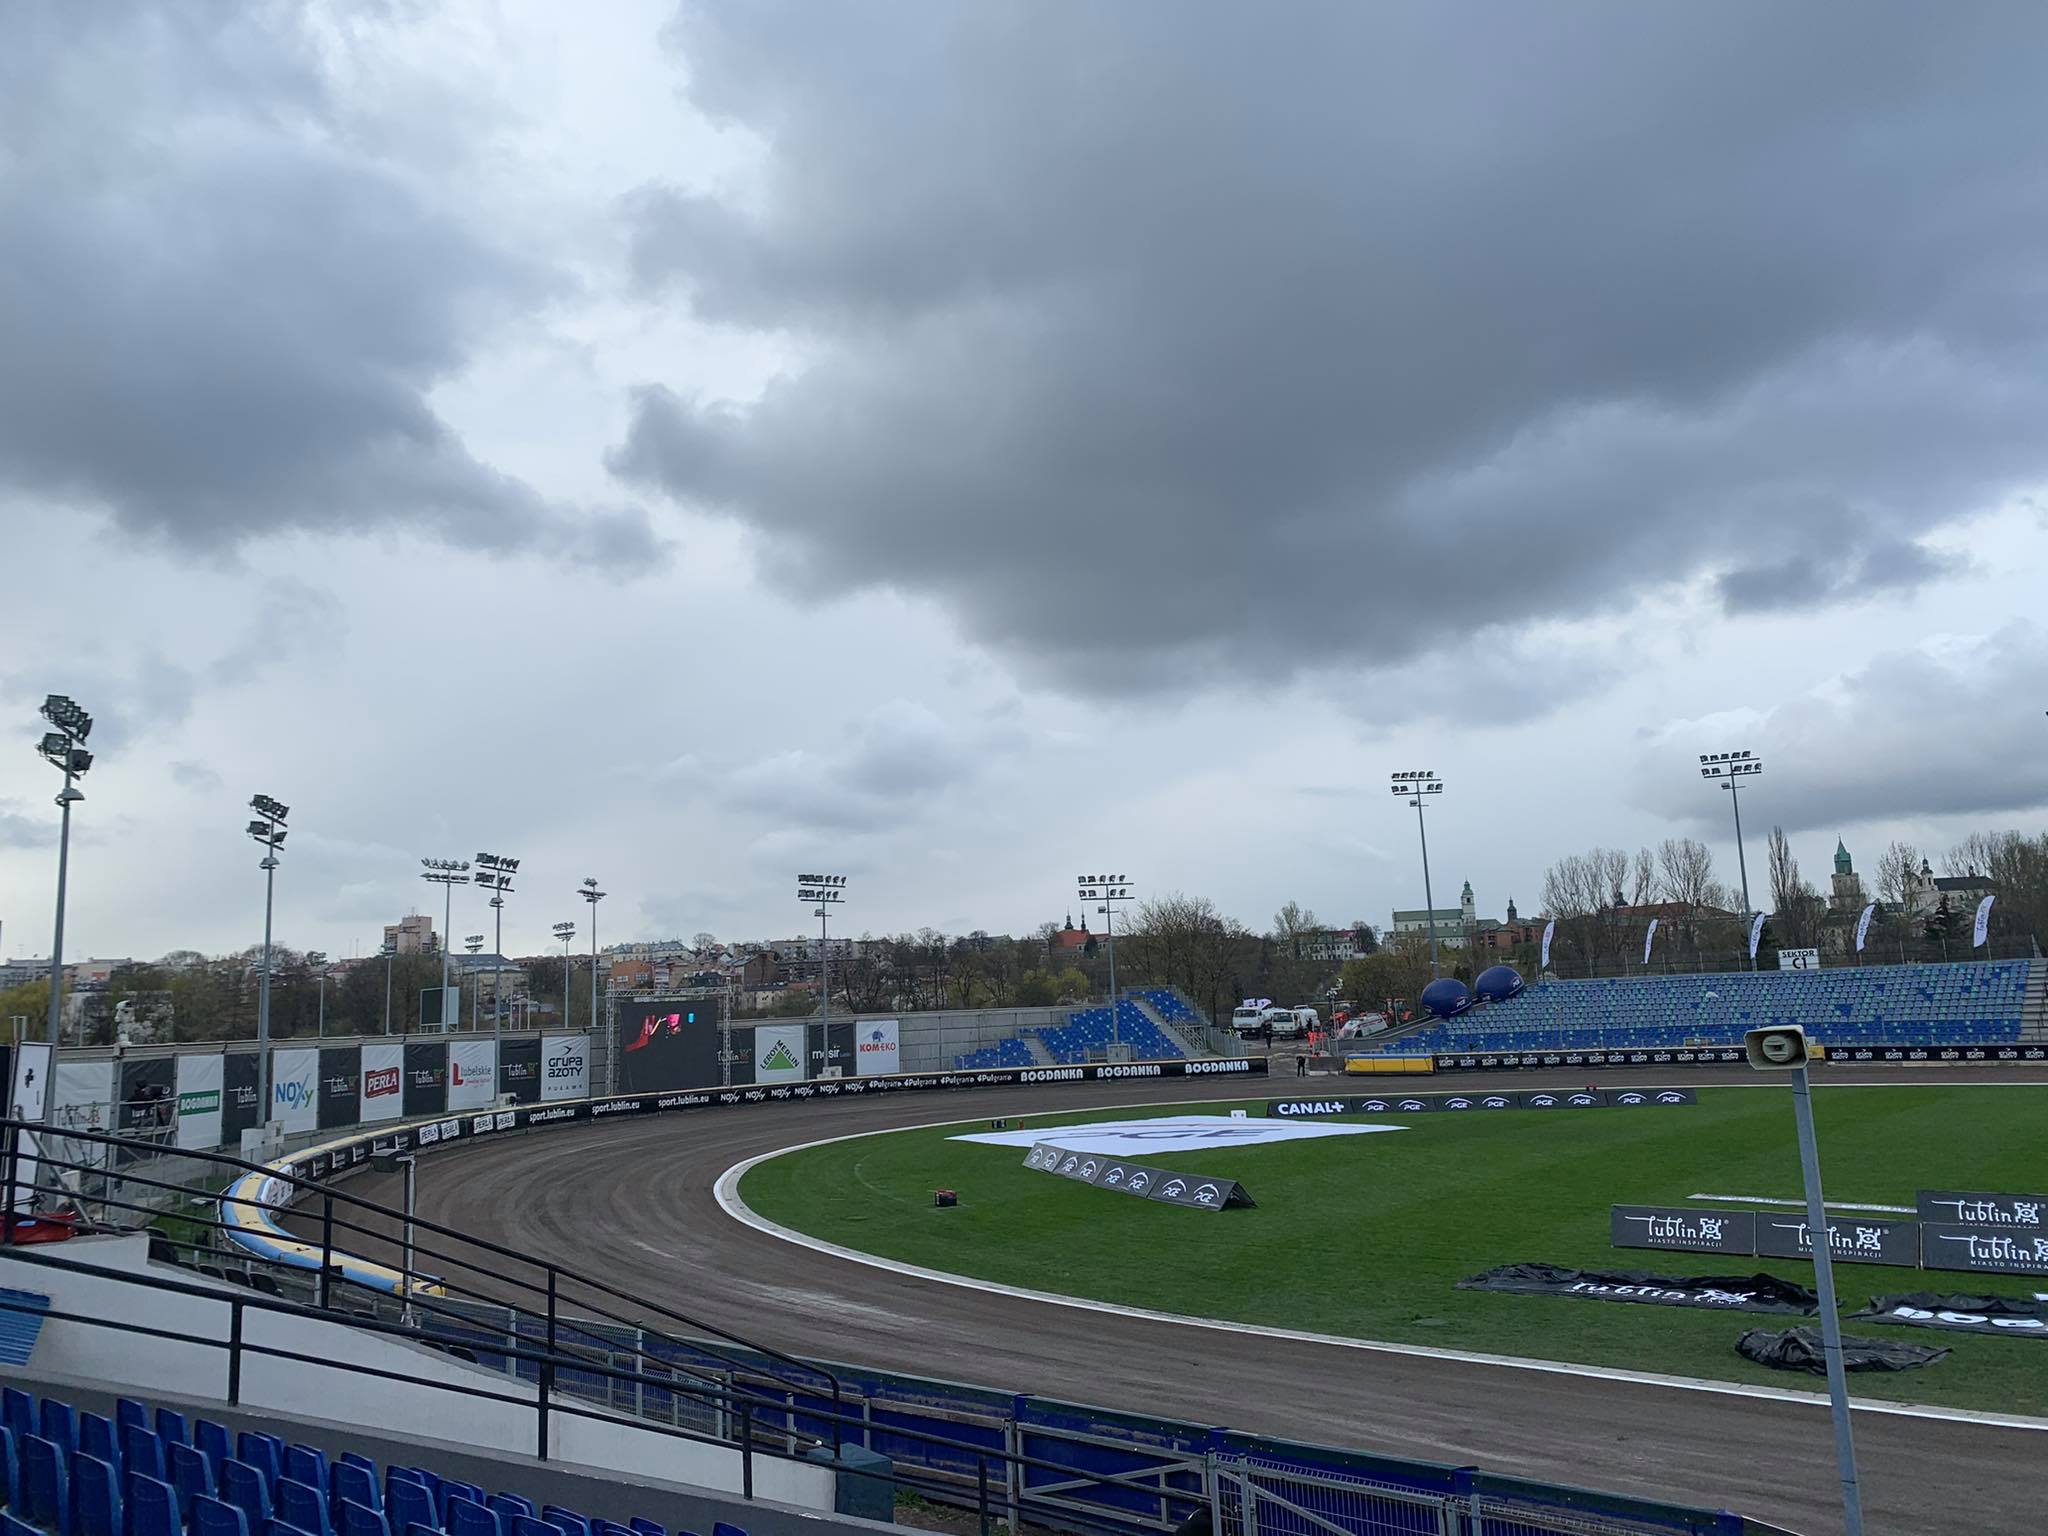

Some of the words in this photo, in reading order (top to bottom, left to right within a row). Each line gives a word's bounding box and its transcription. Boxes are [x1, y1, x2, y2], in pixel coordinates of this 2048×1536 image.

[1782, 950, 1815, 958] SEKTOR
[1792, 957, 1807, 969] C1
[760, 1045, 778, 1070] LEROY
[776, 1039, 800, 1067] MERLIN
[1097, 1065, 1161, 1078] BOGDANKA
[1185, 1060, 1249, 1074] BOGDANKA
[1021, 1068, 1083, 1082] BOGDANKA
[367, 1073, 397, 1092] PERŁA
[658, 1094, 710, 1107] sport.lublin.eu
[592, 1101, 640, 1115] sport.lublin.eu
[1278, 1101, 1345, 1115] CANAL+
[529, 1108, 575, 1123] sport.lublin.eu
[1080, 1167, 1092, 1177] PGE
[1105, 1173, 1120, 1184] PGE
[1129, 1178, 1145, 1190] PGE
[1163, 1187, 1181, 1198] PGE
[1193, 1191, 1213, 1203] PGE
[1679, 1239, 1722, 1248] INSPIRACJI
[1833, 1249, 1882, 1259] INSPIRACJI
